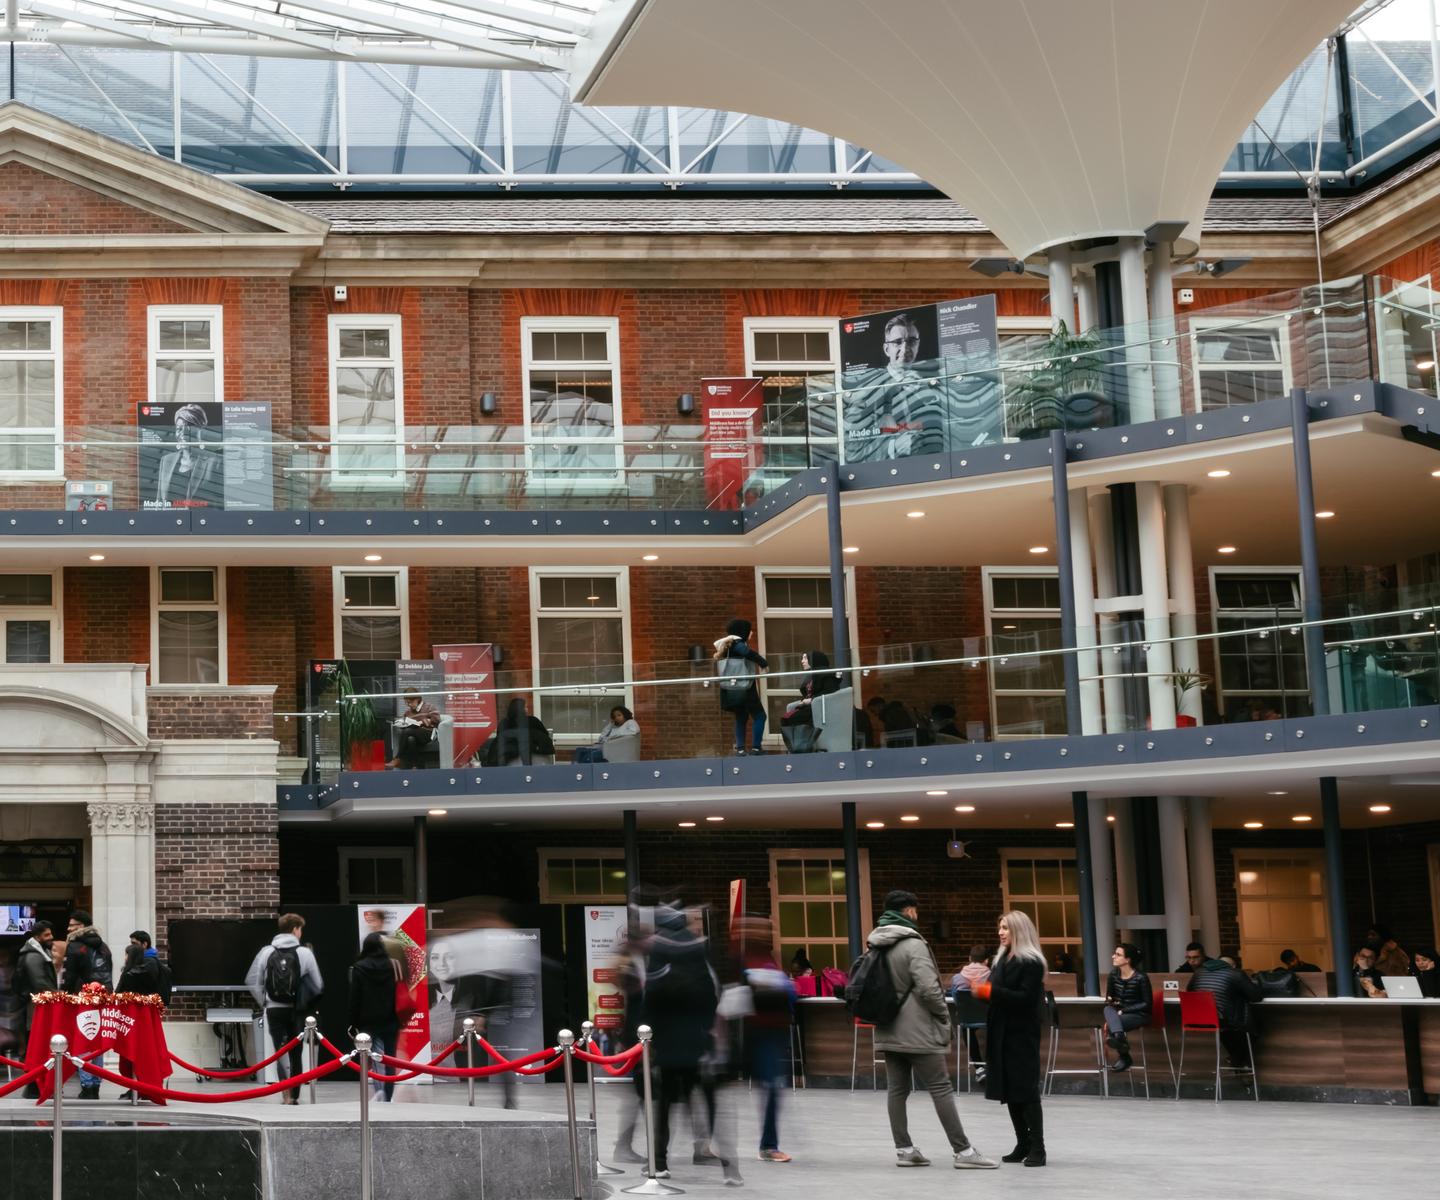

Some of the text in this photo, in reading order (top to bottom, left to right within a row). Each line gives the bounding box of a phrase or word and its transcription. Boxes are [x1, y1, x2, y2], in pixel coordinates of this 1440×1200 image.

[952, 303, 977, 312] Chandler
[849, 428, 870, 438] Made
[872, 427, 880, 435] in
